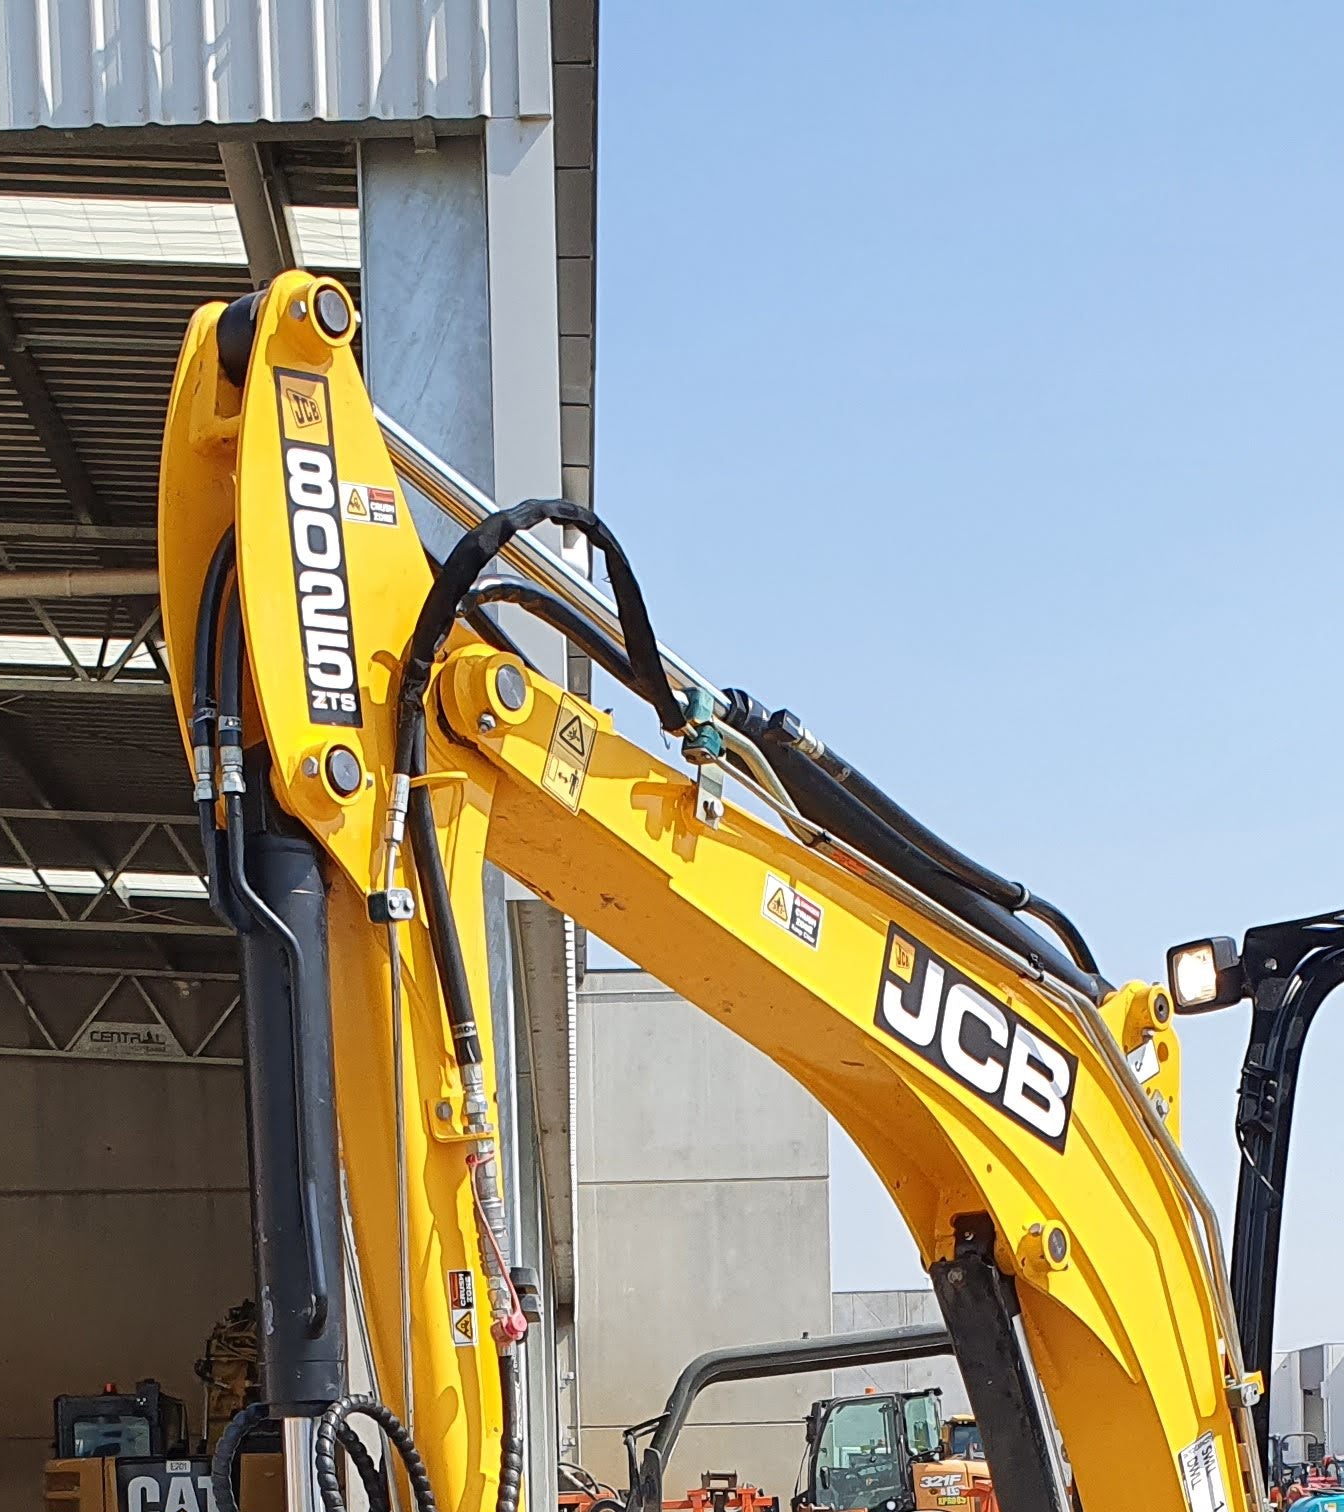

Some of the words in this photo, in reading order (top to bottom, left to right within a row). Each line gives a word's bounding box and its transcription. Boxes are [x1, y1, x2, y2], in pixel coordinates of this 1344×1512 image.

[292, 393, 320, 424] JCB
[286, 447, 354, 690] 8025
[311, 690, 357, 711] ZTS
[882, 959, 1070, 1138] JCB
[920, 1475, 961, 1488] 321F
